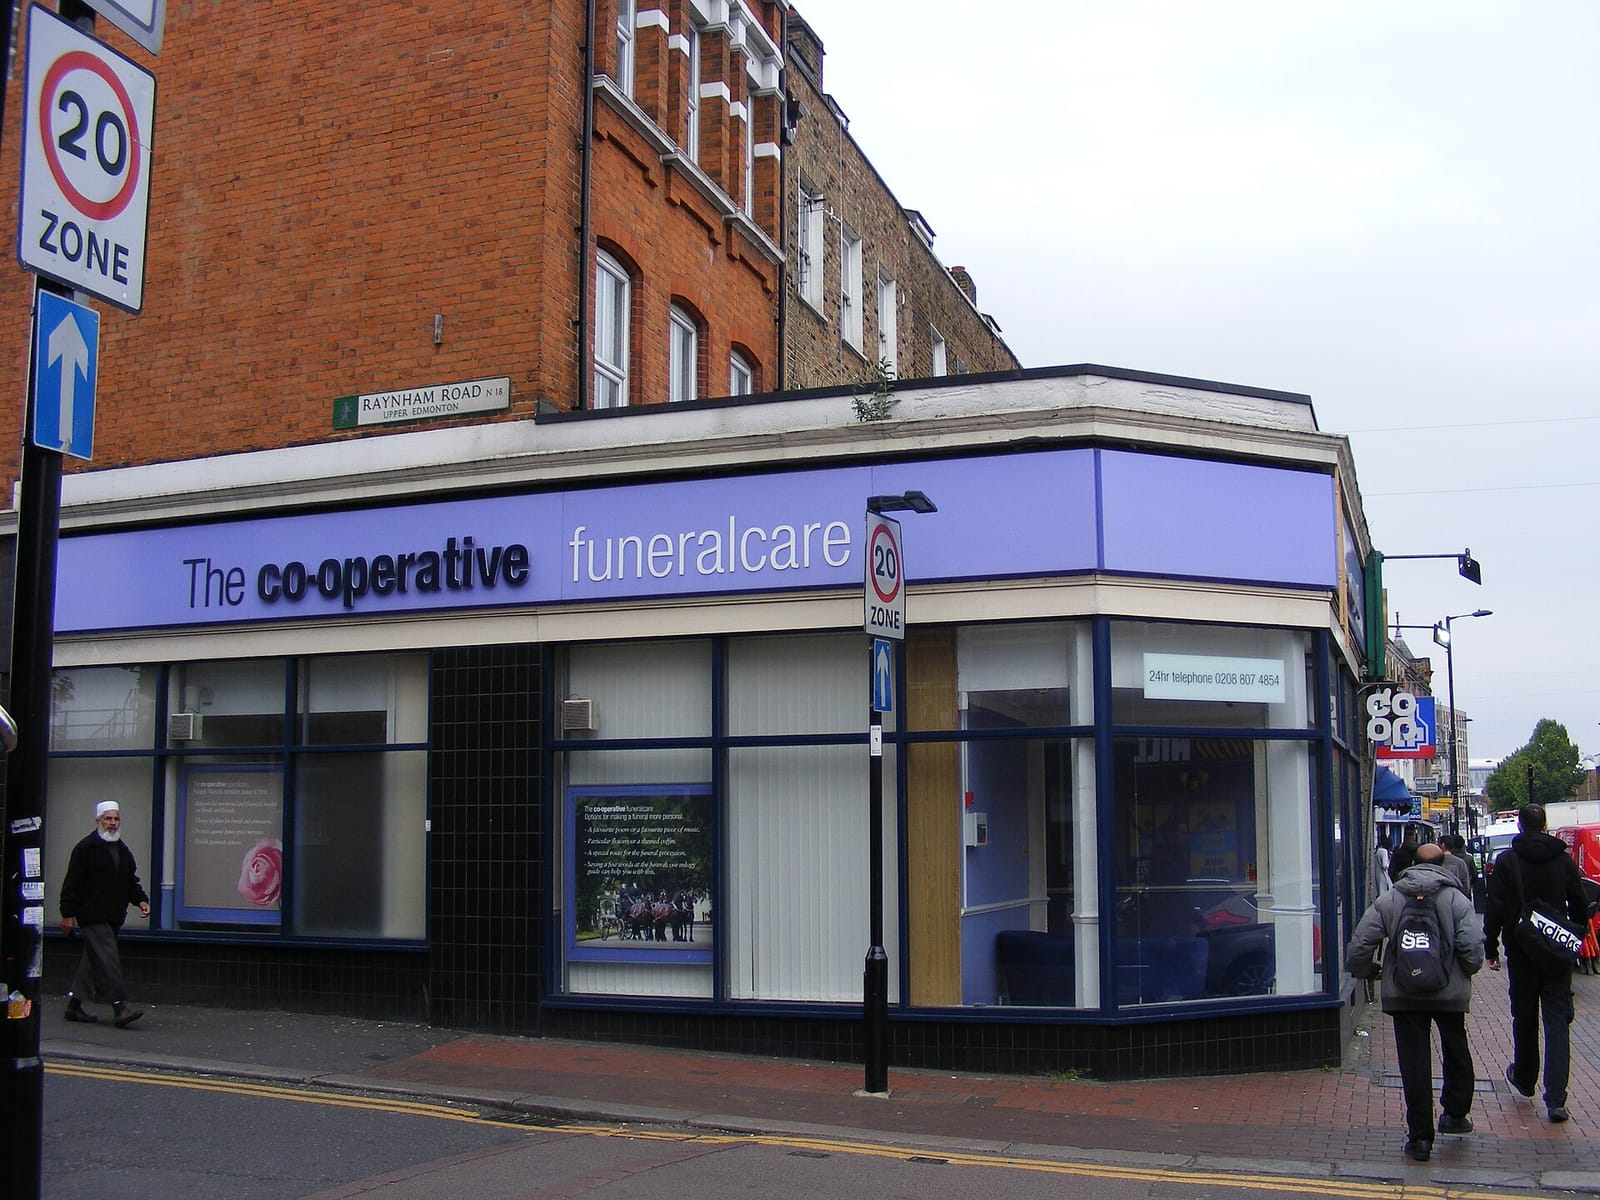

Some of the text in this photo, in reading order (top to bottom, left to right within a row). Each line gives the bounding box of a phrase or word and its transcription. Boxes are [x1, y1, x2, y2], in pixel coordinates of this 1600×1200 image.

[58, 90, 127, 176] 20
[39, 209, 129, 285] ZONE
[362, 390, 434, 411] RAYNHAM
[441, 385, 482, 400] ROAD
[383, 403, 459, 419] UPPER EDMONTON
[183, 515, 851, 608] The co-operative funeralcare
[875, 545, 896, 579] 20
[870, 606, 900, 629] ZONE
[1149, 670, 1280, 686] 24hr telephone 0208 807 4854
